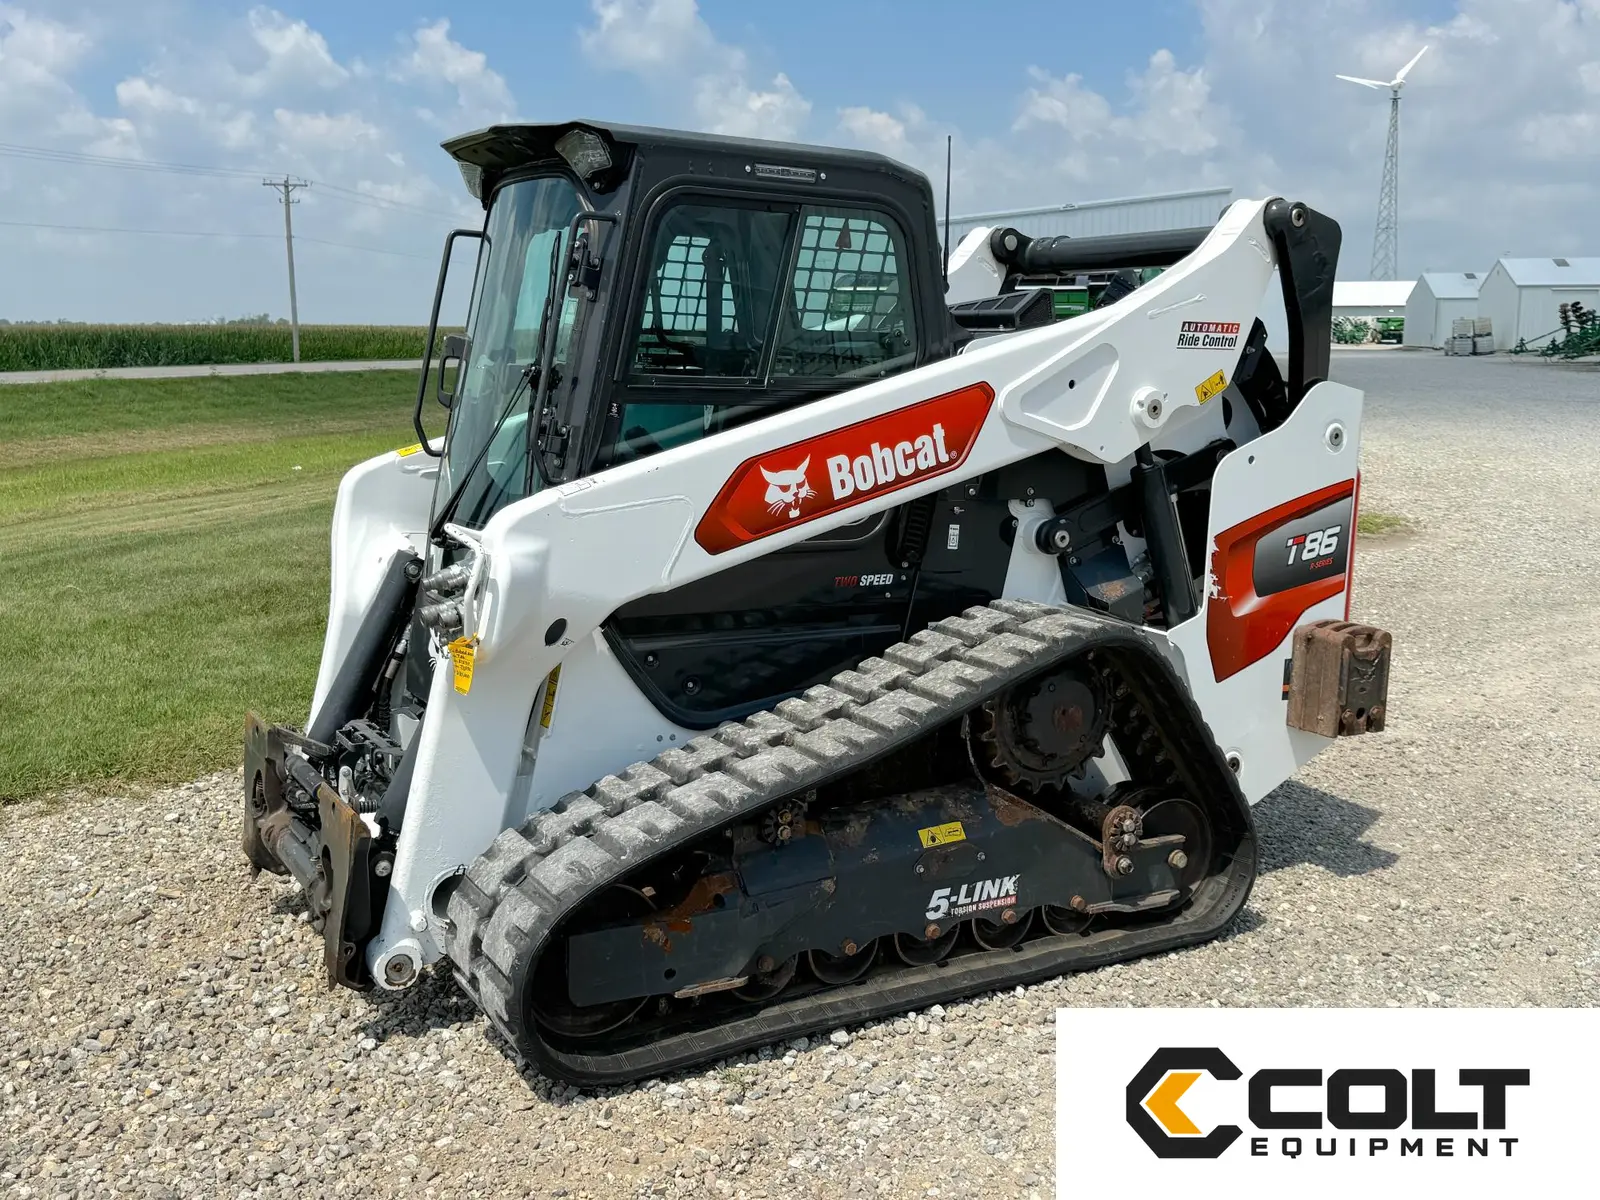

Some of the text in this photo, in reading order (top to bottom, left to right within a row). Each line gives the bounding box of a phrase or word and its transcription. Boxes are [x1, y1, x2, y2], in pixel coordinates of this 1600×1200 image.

[1182, 323, 1239, 333] AUTOMATIC
[1177, 333, 1238, 348] Ride Control
[826, 422, 950, 501] Bobcat
[1286, 525, 1342, 566] T86
[834, 573, 894, 587] TWO SPEED
[925, 873, 1020, 920] 5-LINK
[951, 896, 1016, 916] TORSION SUSPENSION
